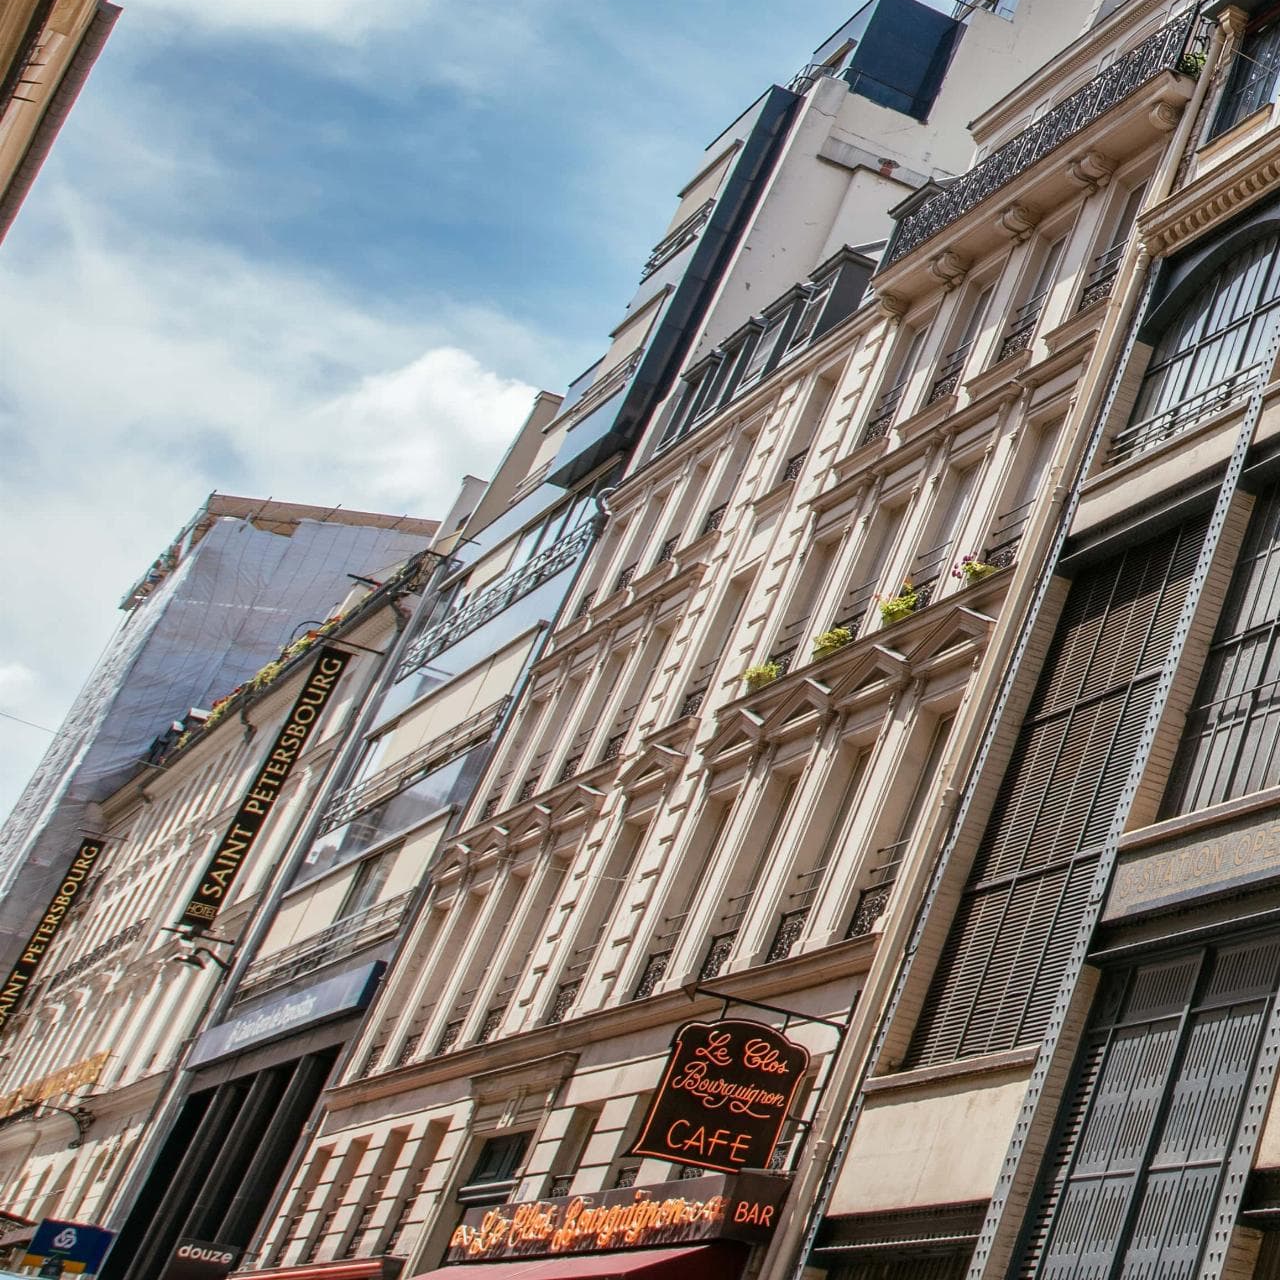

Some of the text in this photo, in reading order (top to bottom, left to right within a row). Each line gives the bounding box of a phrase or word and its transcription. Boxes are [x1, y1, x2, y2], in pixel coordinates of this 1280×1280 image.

[202, 657, 342, 898] SAINT PETERSBOURG
[22, 846, 99, 963] PETERSBOURG
[696, 1031, 789, 1074] Le Clos
[672, 1061, 785, 1118] Bourguignon
[667, 1120, 752, 1162] CAFE
[734, 1201, 774, 1227] BAR
[178, 1244, 233, 1264] douze
